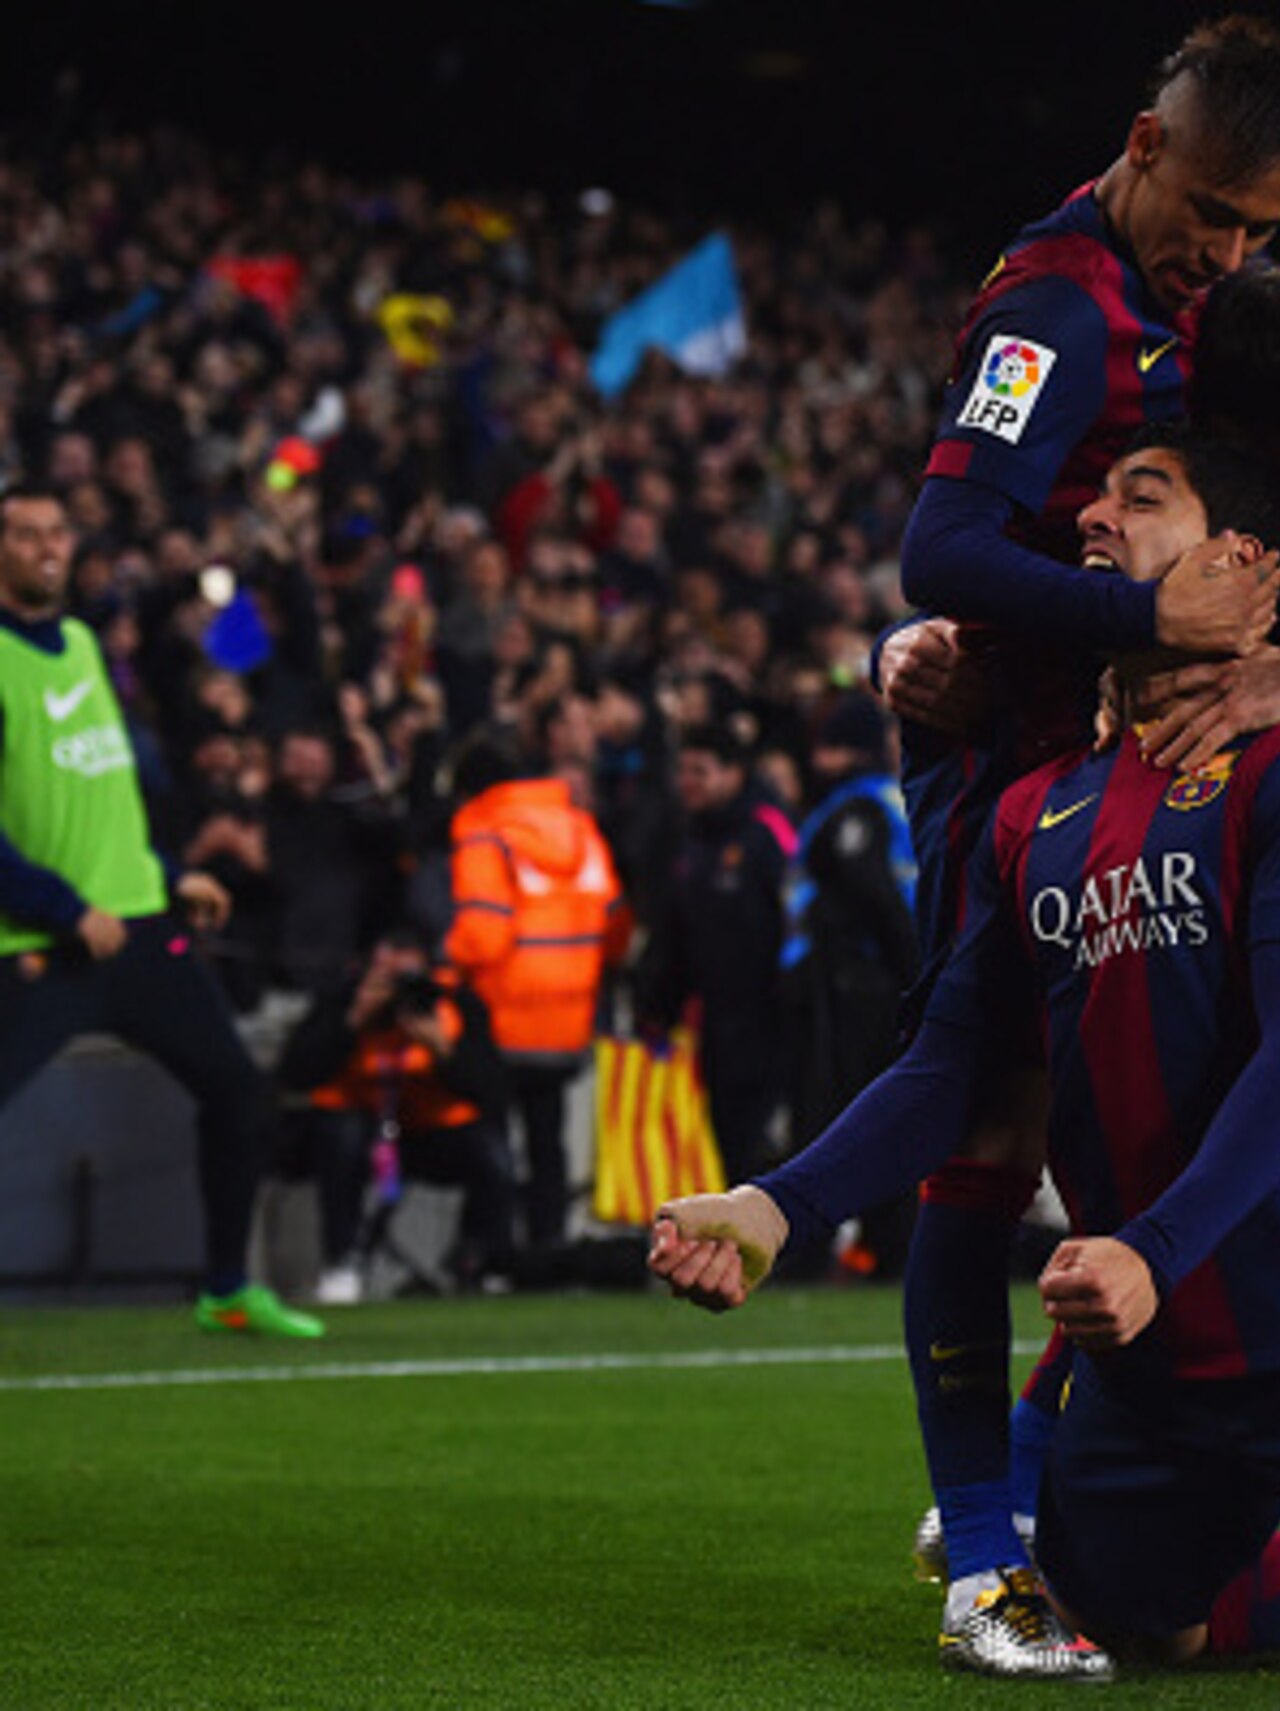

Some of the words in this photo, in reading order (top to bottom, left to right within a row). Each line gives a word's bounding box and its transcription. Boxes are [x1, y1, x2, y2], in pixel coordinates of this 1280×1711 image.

[966, 398, 1018, 430] LFP
[1031, 852, 1203, 948] QATAR
[1075, 909, 1208, 970] AIRWAYS
